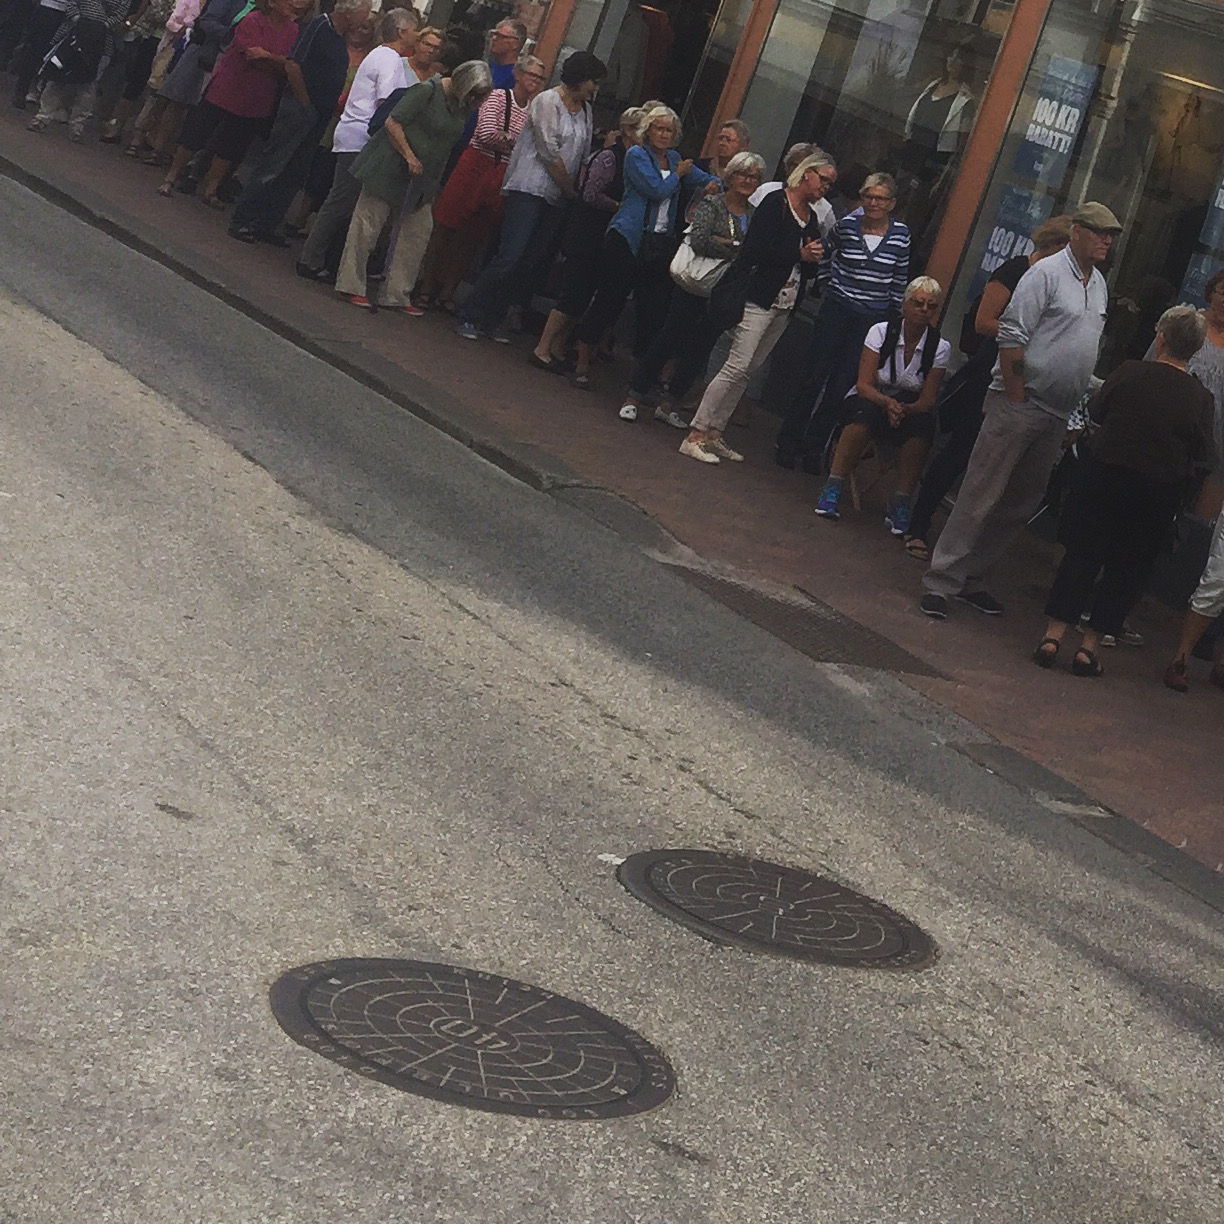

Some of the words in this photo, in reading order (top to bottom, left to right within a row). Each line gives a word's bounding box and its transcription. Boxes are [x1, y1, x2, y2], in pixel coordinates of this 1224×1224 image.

[1032, 97, 1058, 126] 100
[1055, 104, 1080, 133] KR
[1026, 123, 1072, 154] RABATT!
[988, 226, 1015, 256] 100
